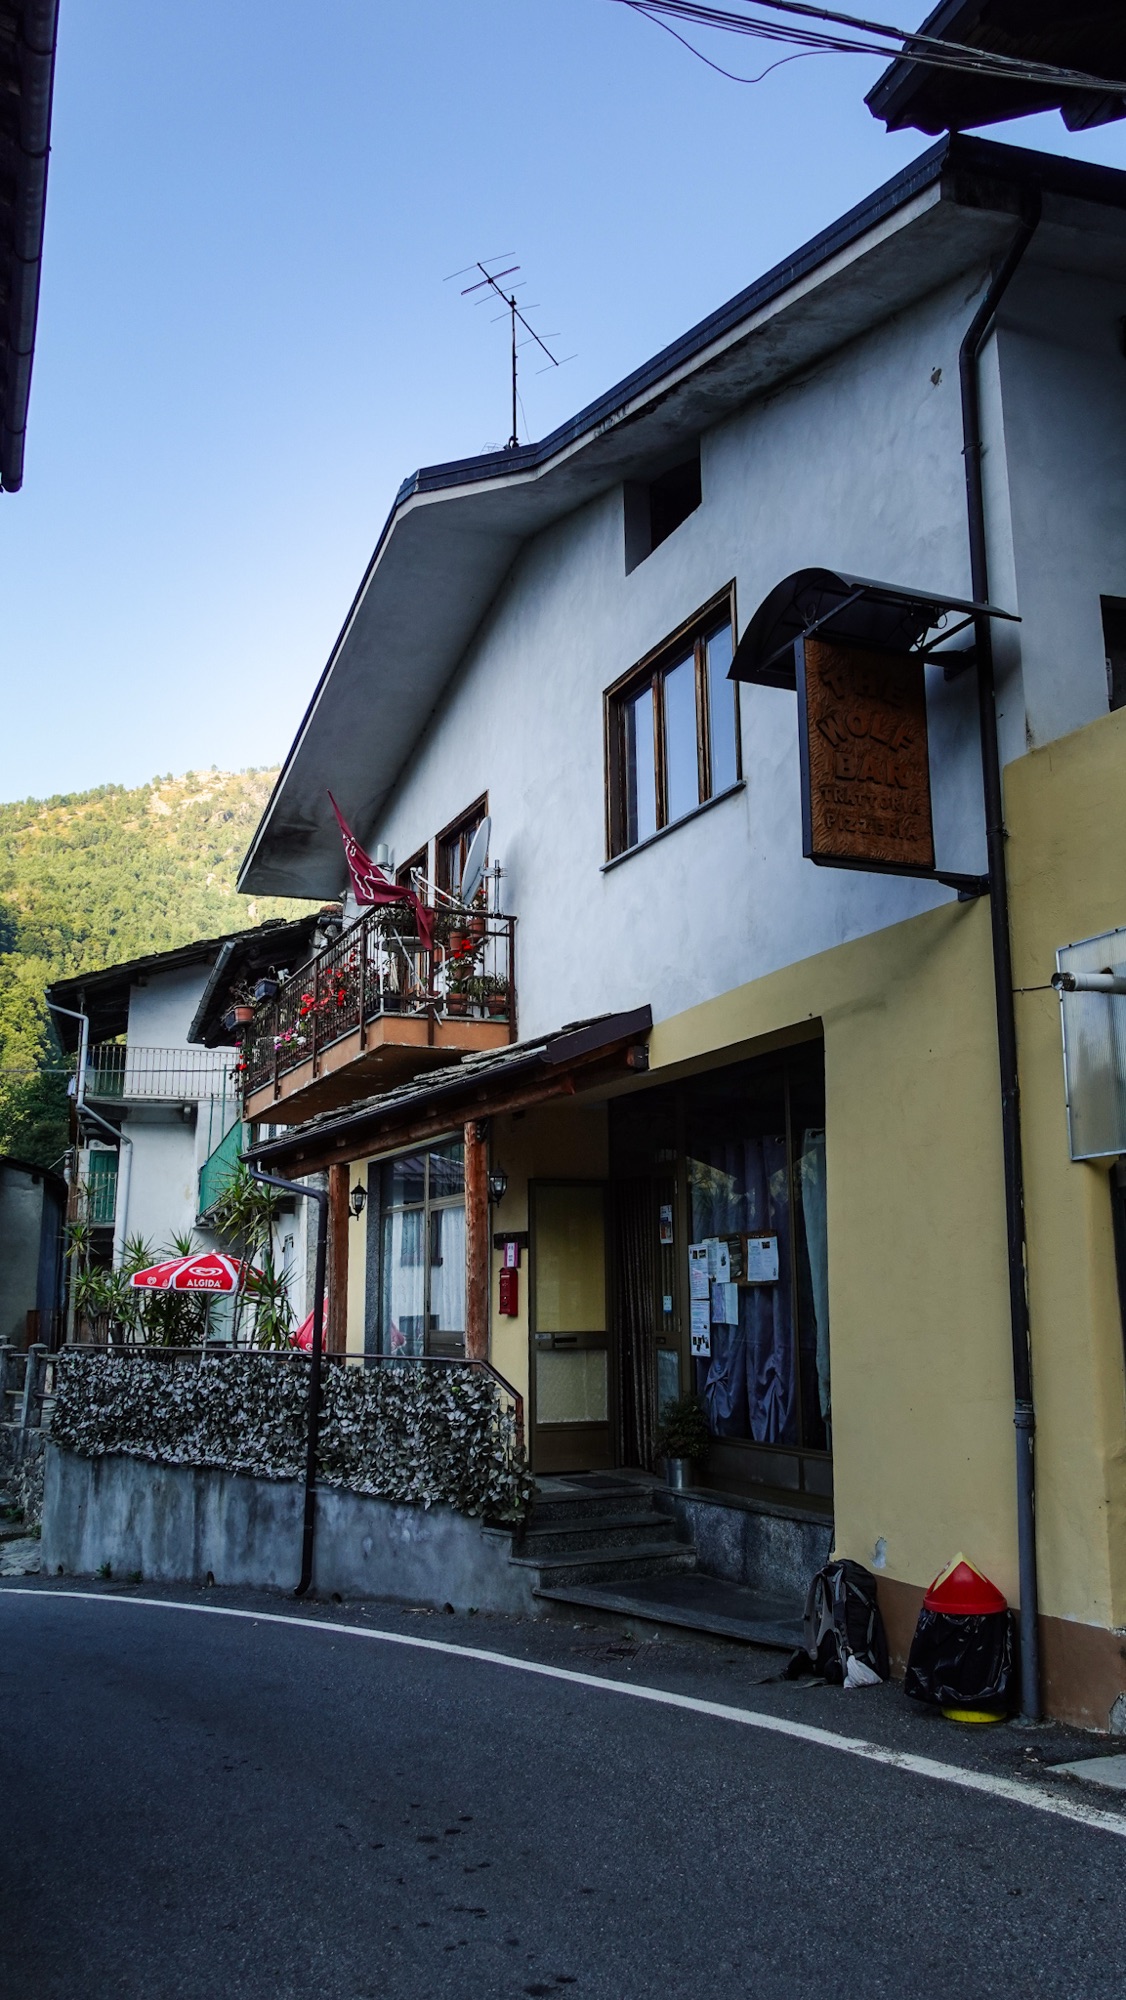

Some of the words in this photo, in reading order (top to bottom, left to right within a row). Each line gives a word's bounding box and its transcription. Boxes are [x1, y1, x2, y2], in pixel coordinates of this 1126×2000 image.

[820, 670, 907, 708] THE
[817, 710, 913, 752] WOLF
[834, 751, 908, 789] BAR
[820, 786, 920, 815] TRATTORIA
[826, 815, 919, 841] PIZZERIA
[186, 1279, 221, 1288] ALGIDA
